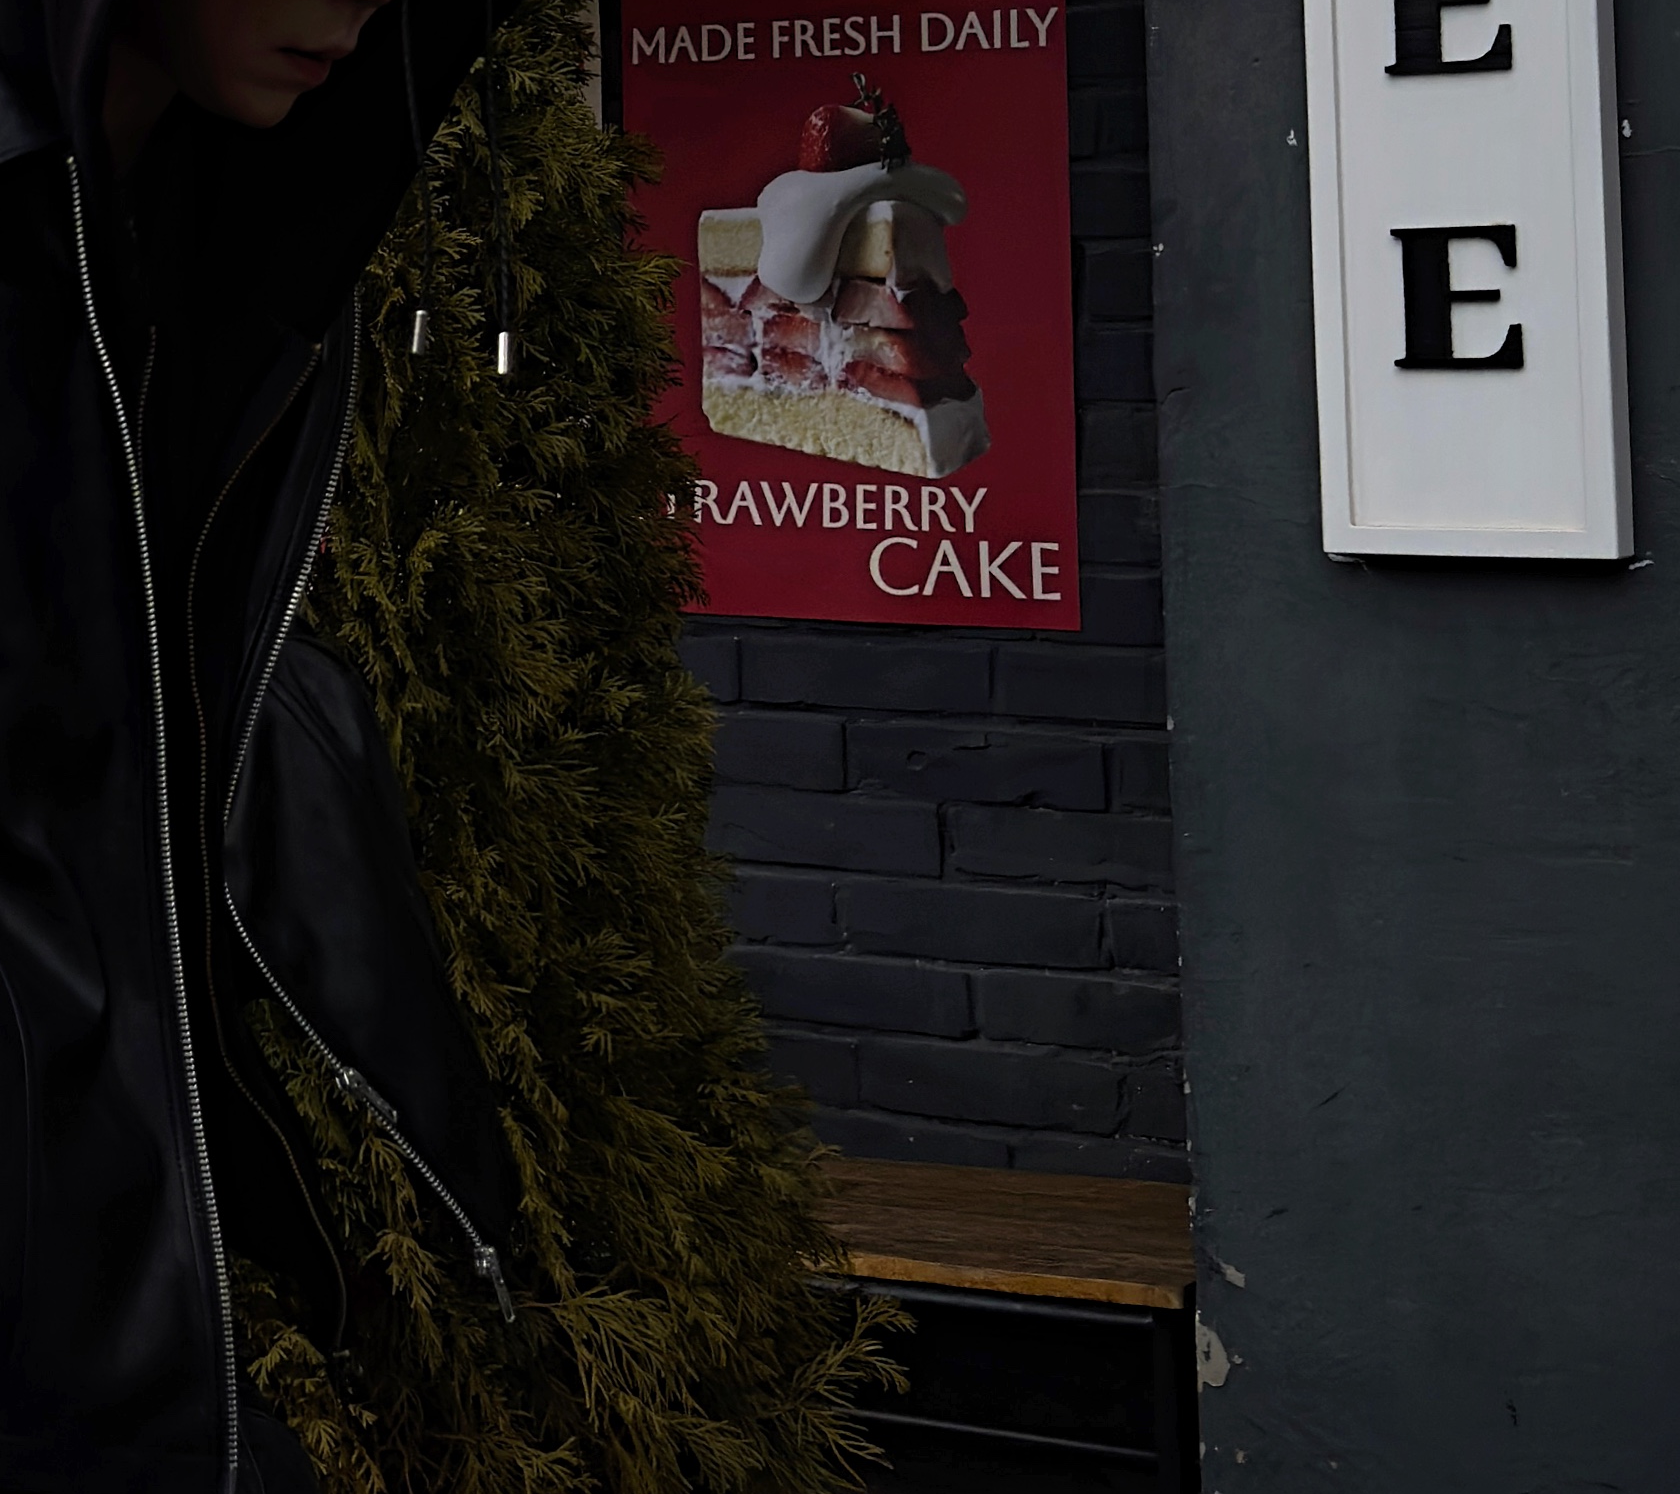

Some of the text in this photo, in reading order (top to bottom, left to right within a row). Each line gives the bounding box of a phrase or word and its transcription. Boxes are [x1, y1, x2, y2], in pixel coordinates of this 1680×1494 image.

[630, 6, 1059, 65] MADE FRESH DAILY
[666, 479, 988, 534] RAWBERRY
[868, 536, 1062, 602] CAKE
